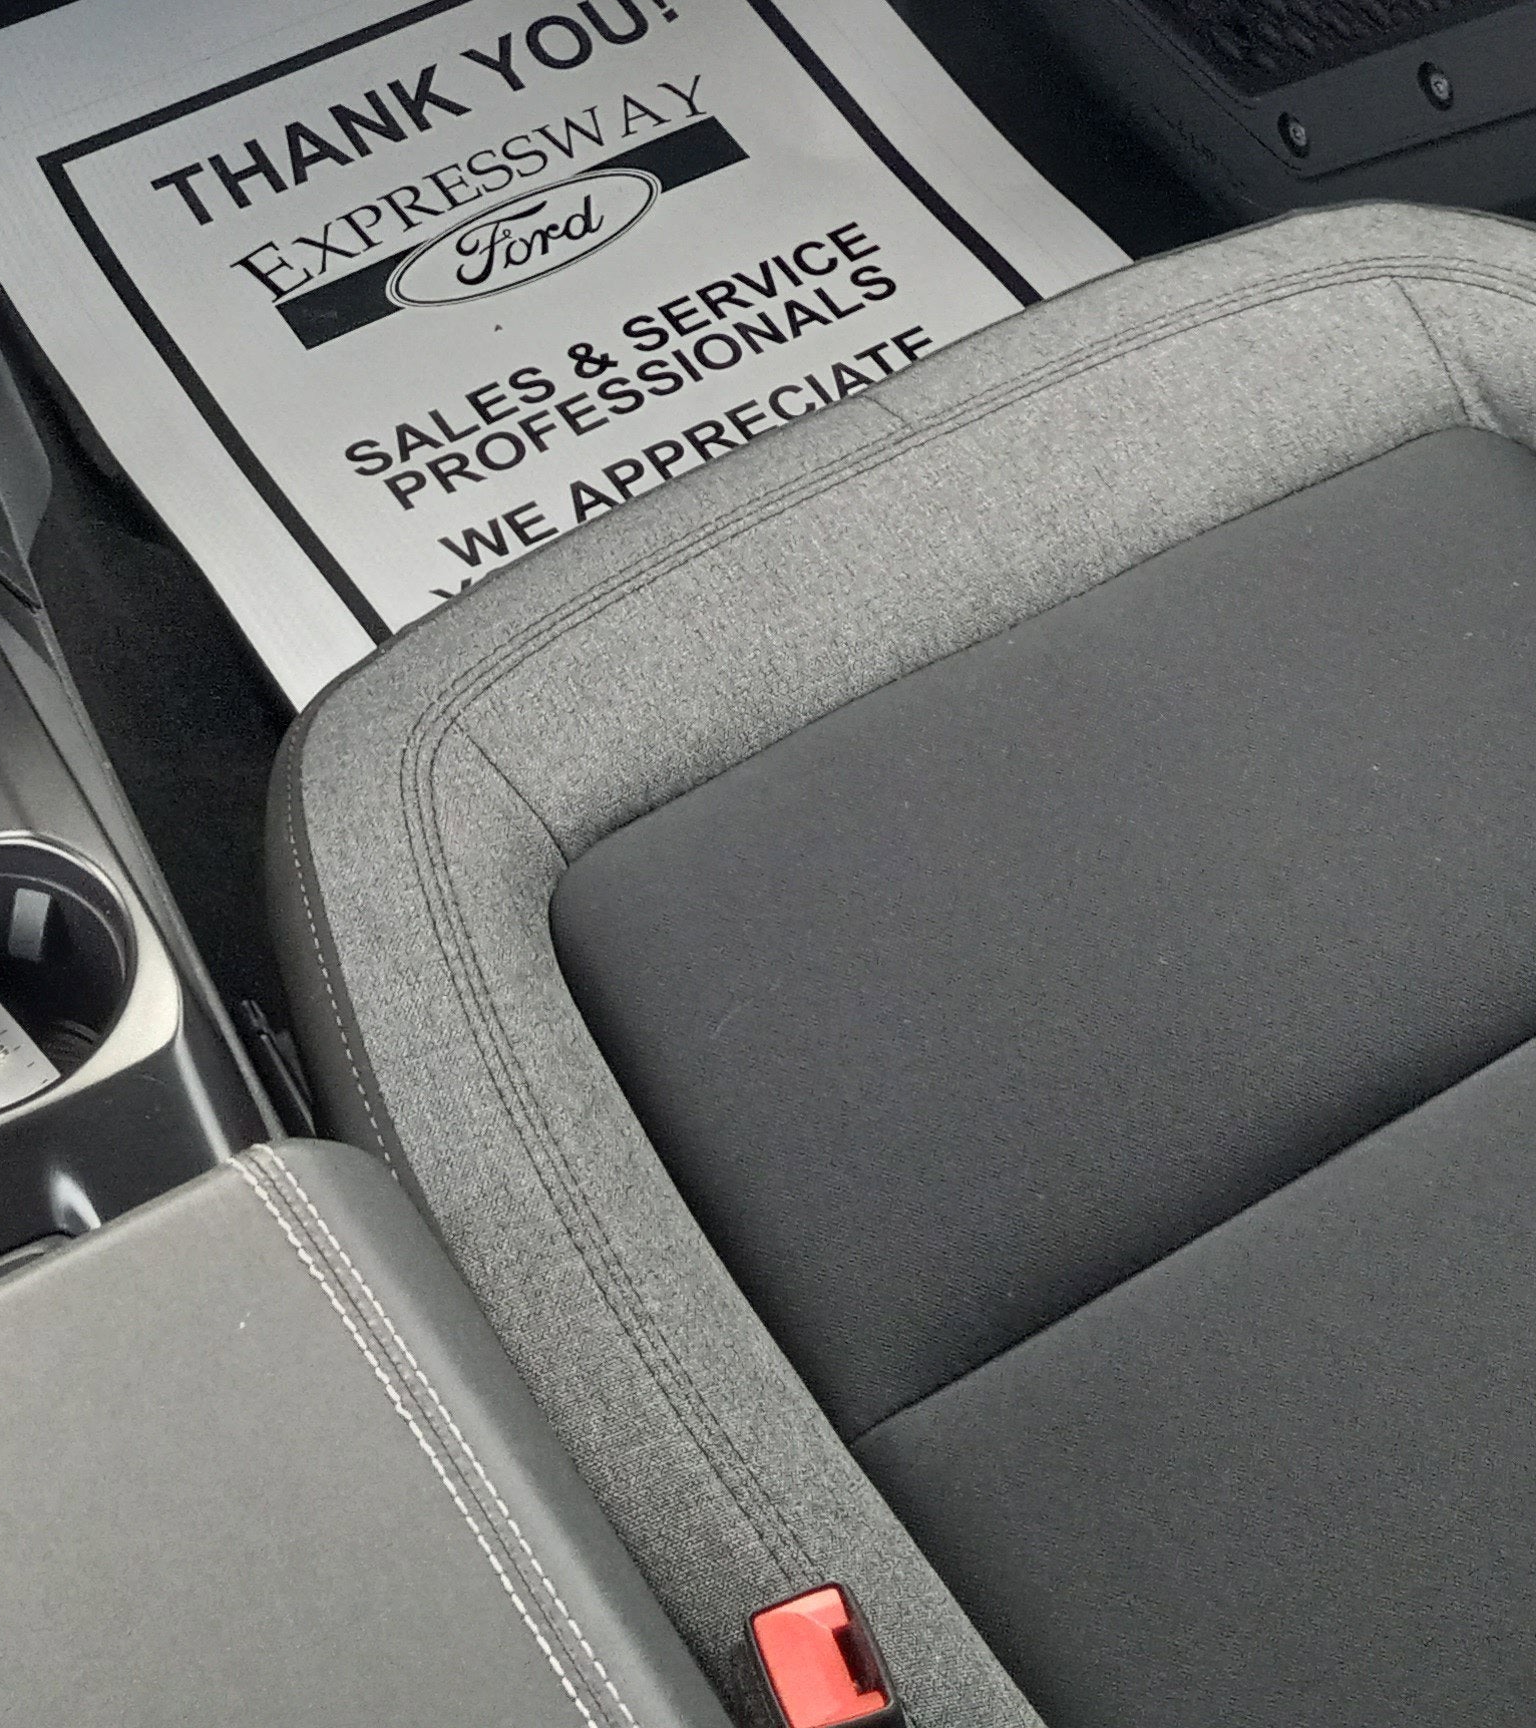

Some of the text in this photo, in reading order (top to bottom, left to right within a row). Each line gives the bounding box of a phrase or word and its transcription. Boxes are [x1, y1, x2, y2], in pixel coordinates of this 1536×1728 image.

[151, 65, 472, 226] THANK
[230, 75, 709, 304] EXPRESSWAY
[455, 194, 605, 287] Ford
[345, 222, 881, 478] SALES & SERVICE
[383, 264, 898, 510] PROFESSIONALS
[437, 325, 934, 567] WE APPRECIATE
